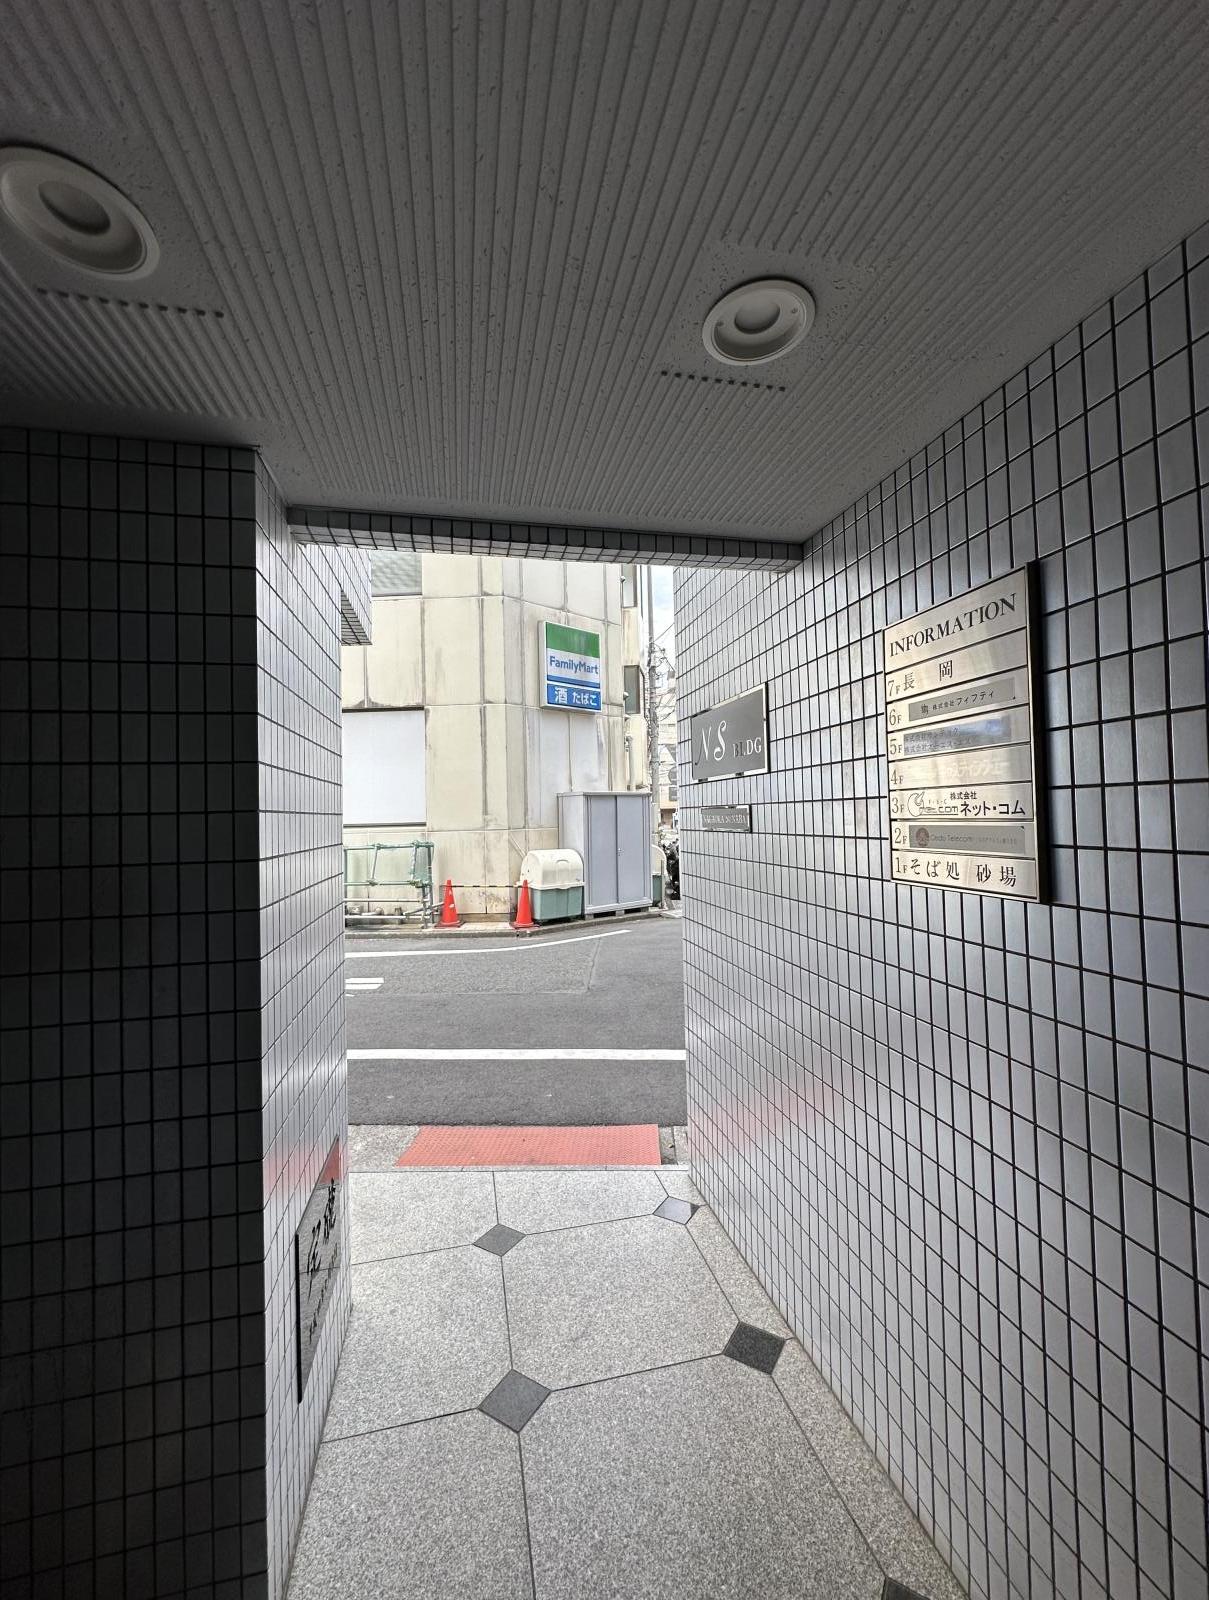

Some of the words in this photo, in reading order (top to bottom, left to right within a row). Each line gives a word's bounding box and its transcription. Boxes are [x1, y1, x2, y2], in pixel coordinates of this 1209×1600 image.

[889, 593, 1017, 657] INFORMATION
[549, 655, 599, 675] FamilyMart
[555, 687, 568, 704] 酒
[572, 691, 598, 706] たばこ
[888, 680, 900, 697] 7F
[889, 708, 902, 726] 6F
[889, 738, 902, 755] 5F
[890, 770, 904, 785] 4F
[950, 791, 977, 800] 株式会社
[891, 797, 905, 814] 3F
[960, 800, 1026, 817] ネット・コム
[894, 827, 908, 845] 2F
[895, 857, 908, 873] 1F
[910, 858, 960, 881] そば処
[976, 864, 1017, 887] 砂場
